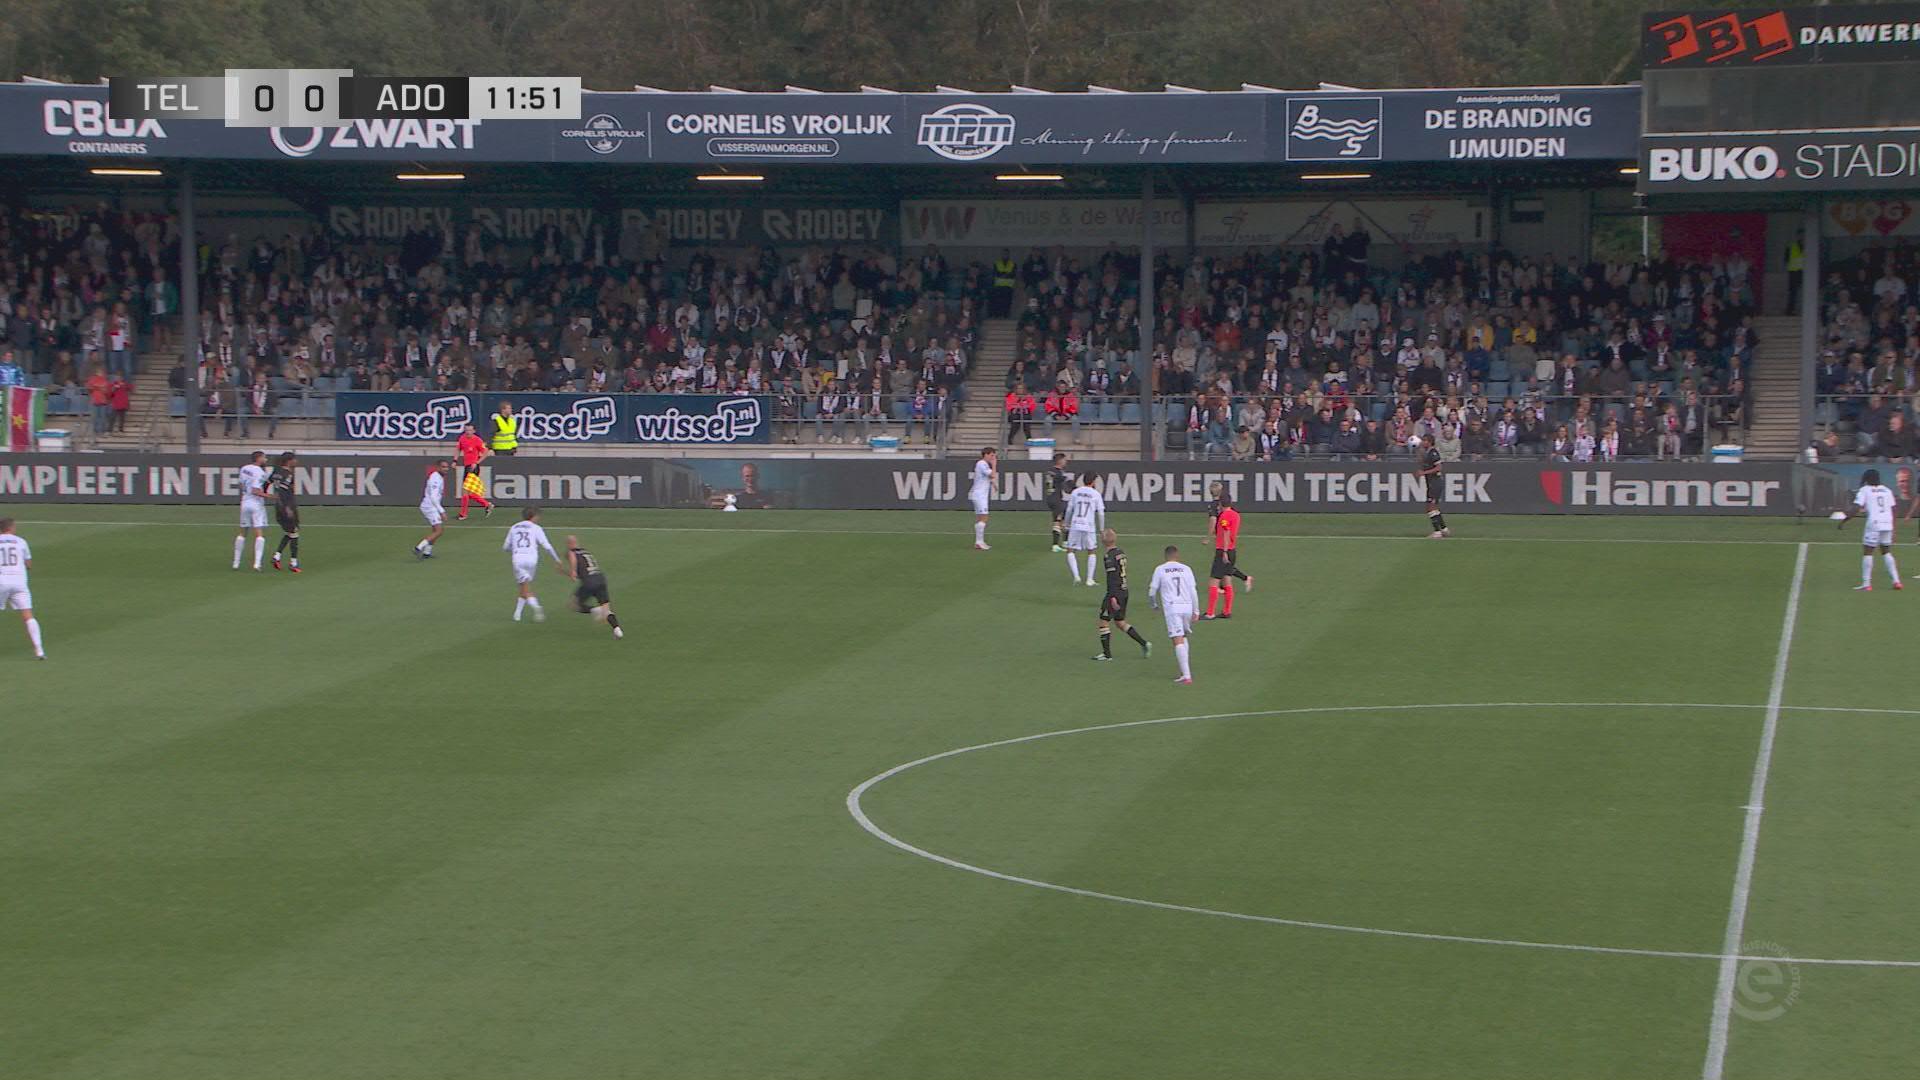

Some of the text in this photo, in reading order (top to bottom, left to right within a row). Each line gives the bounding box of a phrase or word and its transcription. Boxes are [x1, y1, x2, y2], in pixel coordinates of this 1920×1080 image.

[1648, 11, 1794, 64] PBL
[1456, 94, 1561, 105] Aannemingsmaatschappij
[666, 114, 892, 135] CORNELIS VROLIJK
[1297, 105, 1320, 125] B
[1425, 107, 1592, 129] DE BRANDING
[329, 119, 482, 149] ZWART
[561, 130, 646, 138] CORNELIS VROLIJK
[1020, 128, 1095, 155] Moving
[1101, 129, 1159, 155] things
[69, 141, 148, 154] CONTAINERS
[717, 143, 831, 154] VISSERSVANMORGEN.NL
[1339, 136, 1363, 155] S
[1449, 138, 1567, 159] IJMUIDEN
[1795, 143, 1920, 180] STADI
[797, 209, 883, 240] ROBEY
[984, 207, 1051, 225] Venus
[1058, 208, 1072, 225] &
[1081, 207, 1107, 225] de
[346, 401, 468, 439] wissel.nl
[636, 403, 757, 442] wissel.nl
[149, 466, 190, 495] IN
[893, 471, 957, 501] WIJ
[1254, 472, 1295, 502] IN
[1304, 472, 1492, 502] TECHNEK
[1571, 471, 1780, 507] Hamer
[1076, 501, 1091, 518] 17
[517, 531, 531, 548] 23
[0, 546, 17, 567] 16
[1171, 576, 1181, 597] 7
